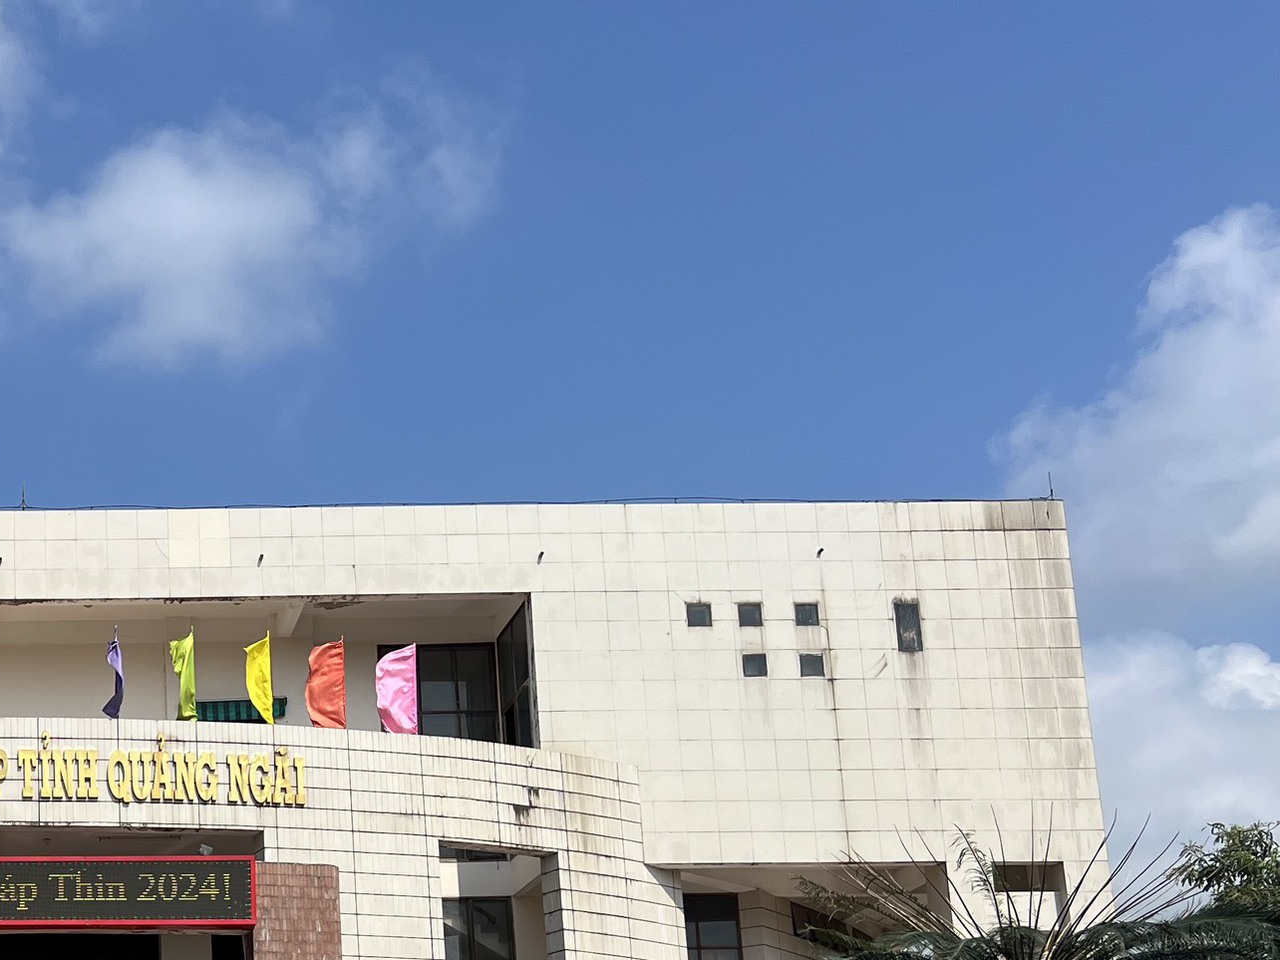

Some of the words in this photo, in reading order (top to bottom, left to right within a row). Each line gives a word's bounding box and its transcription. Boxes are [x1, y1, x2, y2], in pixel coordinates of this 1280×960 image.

[17, 729, 98, 800] TỈNH
[106, 733, 218, 804] QUẢNG
[136, 873, 231, 901] 2024!
